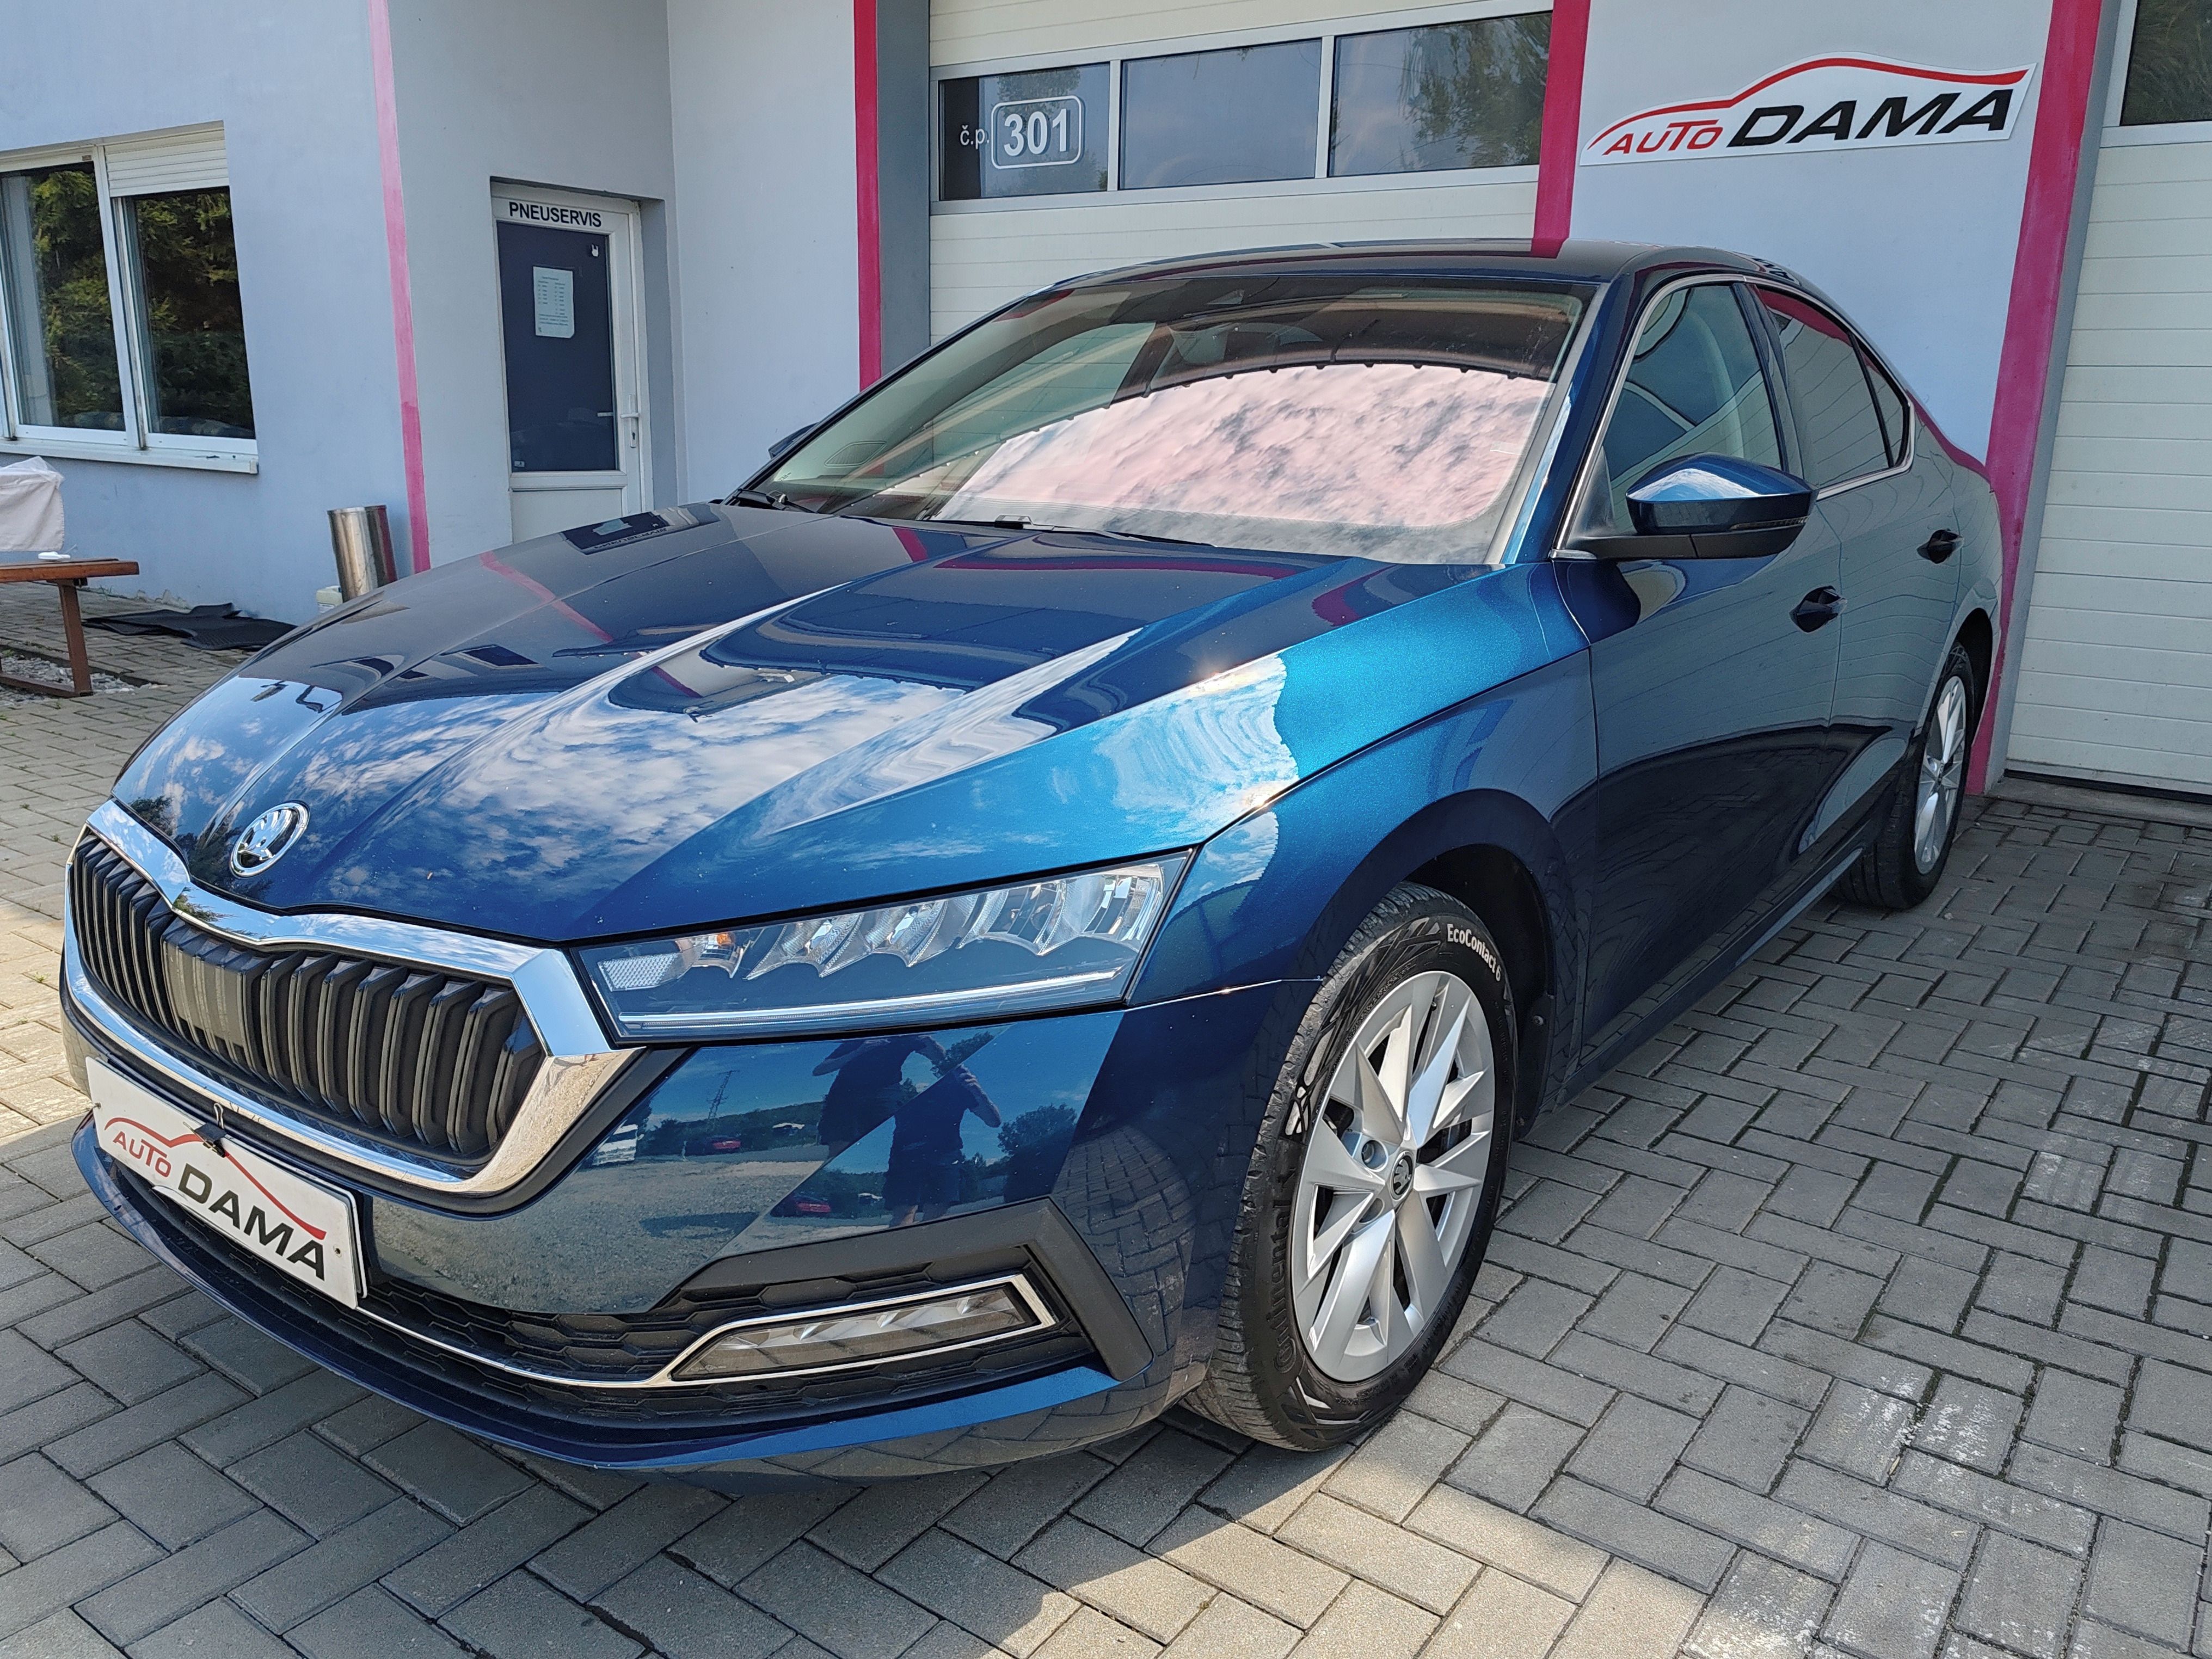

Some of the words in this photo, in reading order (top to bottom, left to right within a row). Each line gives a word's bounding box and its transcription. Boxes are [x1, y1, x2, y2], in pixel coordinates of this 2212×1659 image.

[960, 125, 990, 150] č.p.
[1004, 108, 1067, 156] 301
[1602, 119, 1723, 156] AUTO
[1726, 89, 2014, 149] DAMA
[509, 201, 601, 228] PNEUSERVIS
[1447, 924, 1497, 973] EcoContact
[1495, 966, 1501, 981] 6
[113, 1131, 171, 1177] AUTO
[177, 1163, 326, 1282] DAMA
